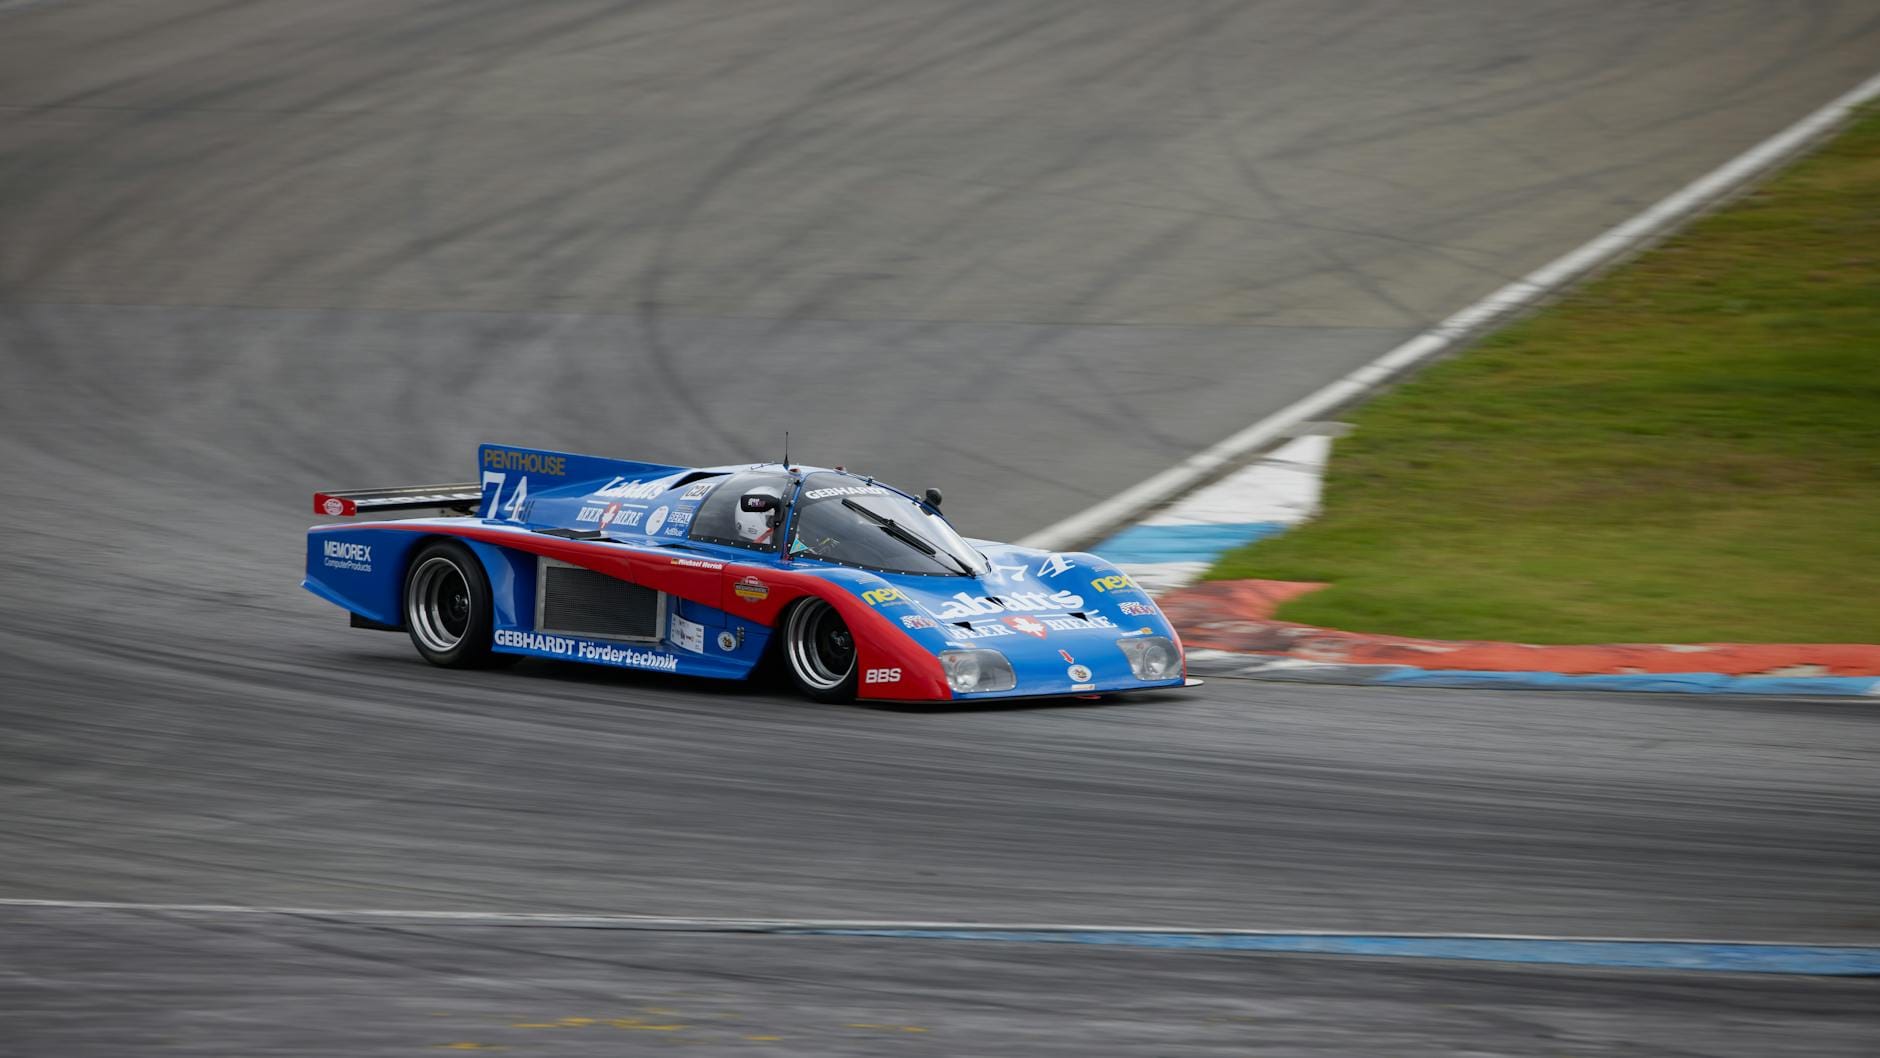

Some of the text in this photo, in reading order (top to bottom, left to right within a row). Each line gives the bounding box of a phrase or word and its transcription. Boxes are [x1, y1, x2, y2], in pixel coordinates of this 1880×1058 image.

[484, 449, 566, 476] PENTHOUSE
[483, 470, 528, 523] 74
[805, 486, 890, 500] GEBHARDT
[576, 507, 604, 523] BEER
[324, 540, 371, 562] MEMOREX
[494, 629, 679, 670] GEBHARDT Fördertechnik
[865, 668, 902, 683] BBS
